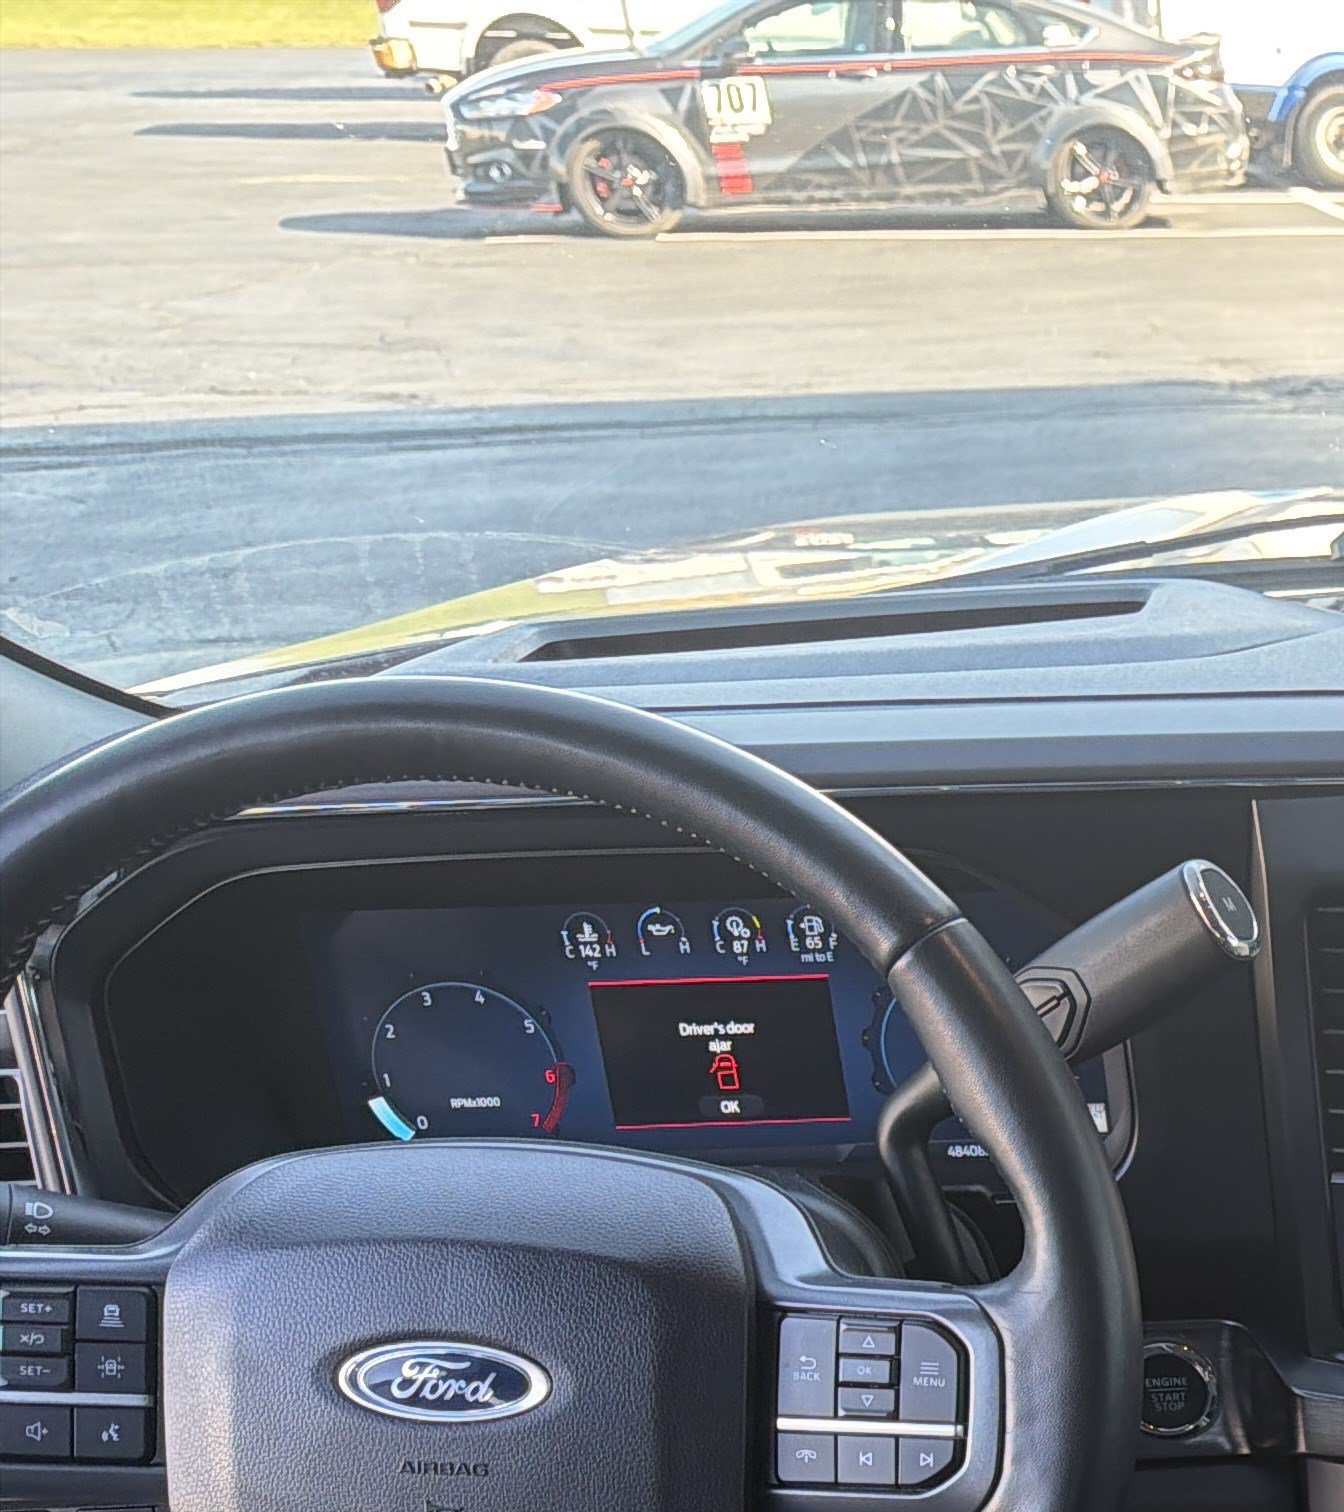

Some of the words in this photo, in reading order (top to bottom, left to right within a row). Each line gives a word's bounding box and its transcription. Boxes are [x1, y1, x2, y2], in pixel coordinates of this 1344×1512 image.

[641, 943, 650, 956] L
[679, 941, 691, 954] H
[716, 940, 726, 954] C
[732, 940, 748, 953] 87
[755, 939, 766, 952] H
[791, 938, 800, 951] E
[805, 936, 823, 949] 65
[829, 936, 838, 950] F
[565, 945, 575, 959] C
[578, 944, 602, 958] 142
[606, 944, 617, 957] H
[800, 952, 814, 963] mi
[815, 953, 825, 962] to
[827, 952, 835, 962] E
[421, 991, 432, 1006] 3
[474, 989, 485, 1004] 4
[385, 1024, 396, 1039] 2
[523, 1019, 535, 1034] 5
[678, 1021, 725, 1036] Driver's
[726, 1020, 755, 1034] door
[708, 1038, 733, 1053] ajar
[382, 1073, 391, 1087] 1
[545, 1070, 556, 1083] 6
[720, 1100, 741, 1114] OK
[416, 1115, 429, 1130] 0
[530, 1113, 540, 1128] 7
[793, 1371, 820, 1382] BACK
[857, 1365, 873, 1375] OK
[391, 1357, 498, 1403] Ford
[912, 1377, 946, 1388] MENU
[1145, 1376, 1188, 1387] ENGINE
[1150, 1391, 1186, 1403] START
[1155, 1401, 1185, 1412] STOP
[400, 1460, 489, 1478] AIRBAG
